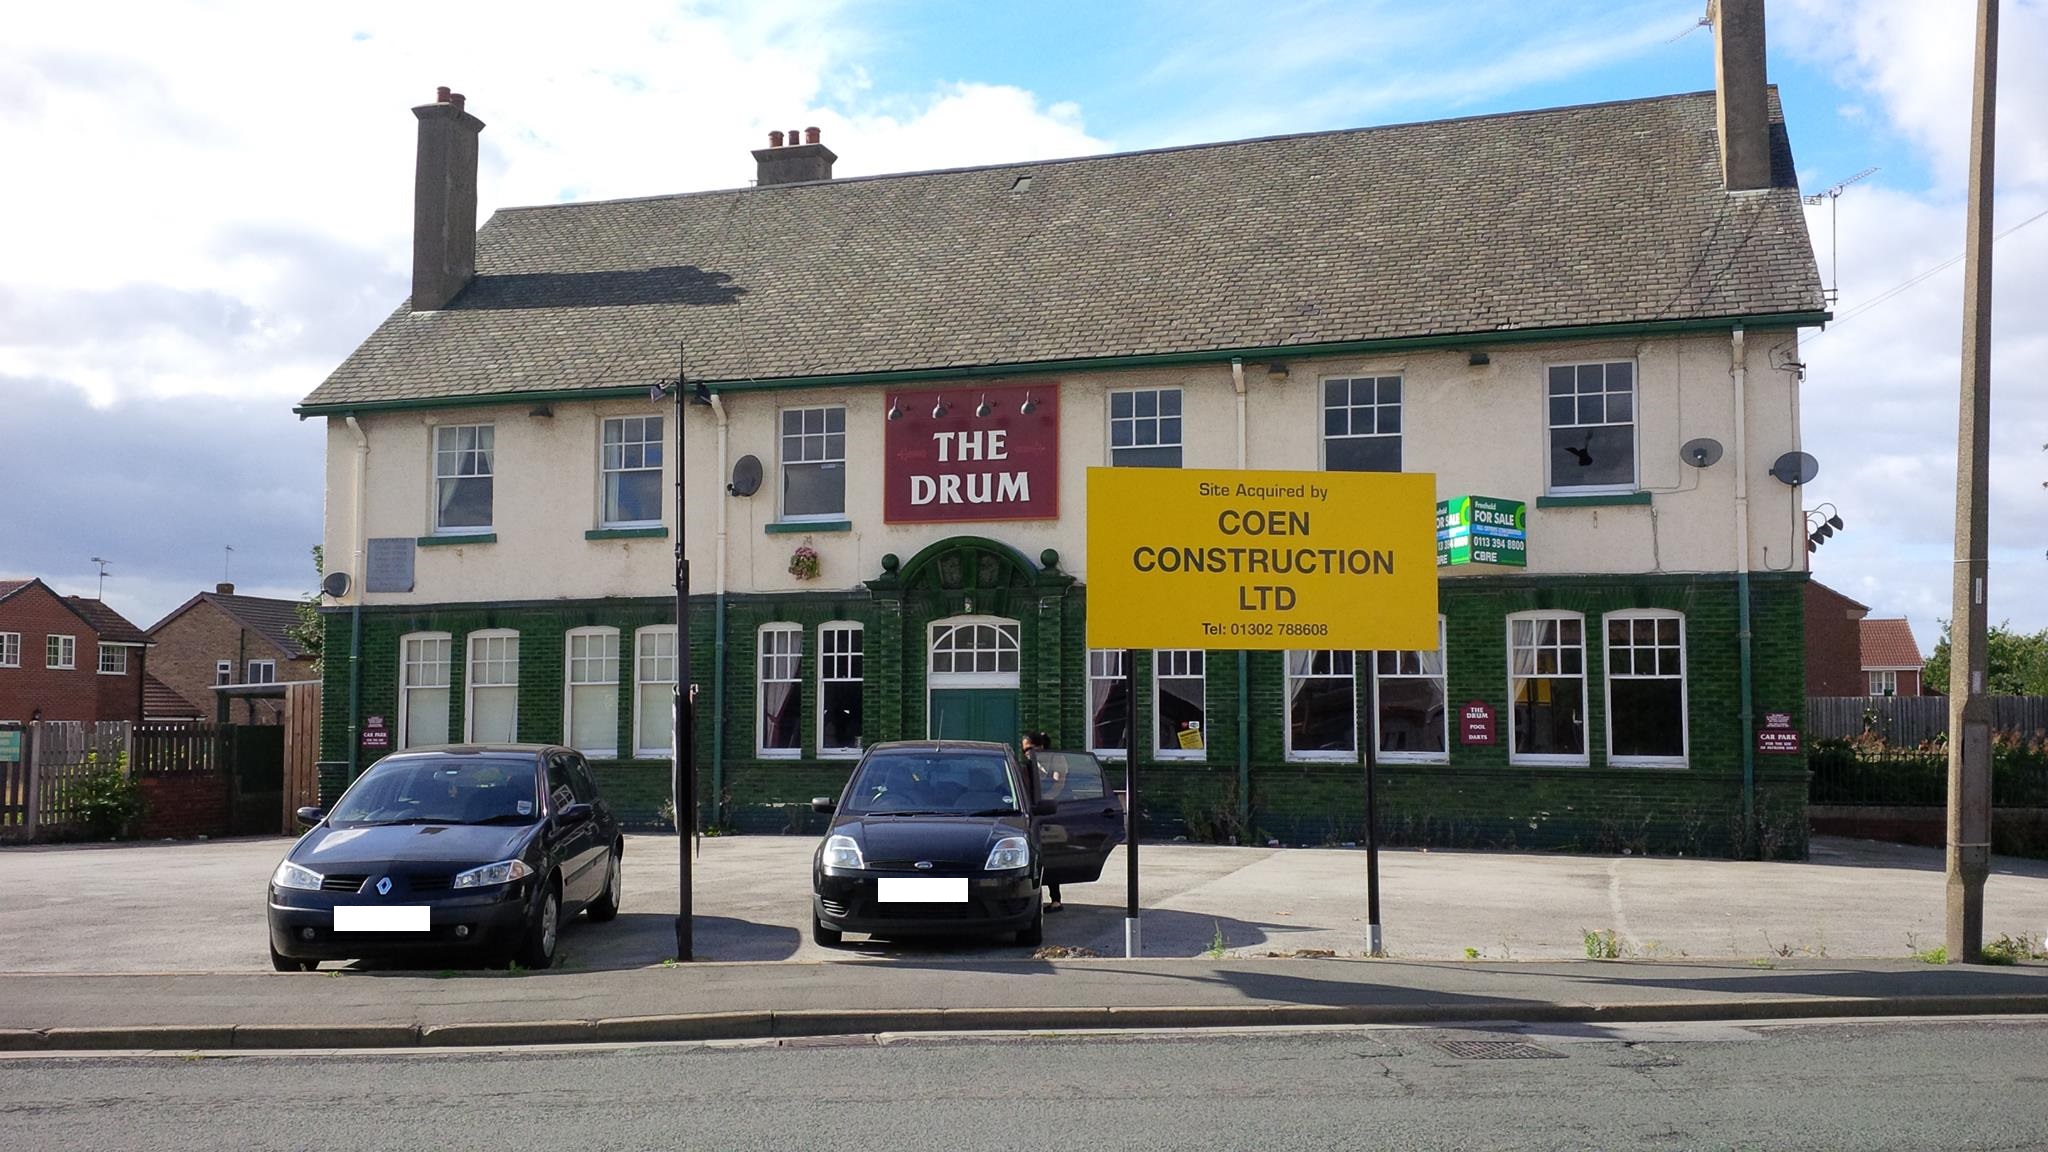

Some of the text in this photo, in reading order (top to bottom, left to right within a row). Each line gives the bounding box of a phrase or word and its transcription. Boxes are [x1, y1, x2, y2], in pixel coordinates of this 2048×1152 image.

[932, 429, 1009, 462] THE
[910, 471, 1030, 505] DRUM
[1199, 482, 1328, 501] Site Acquired by
[1218, 510, 1310, 536] COEN
[1474, 510, 1514, 526] FOR SALE
[1473, 536, 1525, 551] 0113 394 8800
[1133, 546, 1394, 575] CONSTRUCTION
[1473, 551, 1498, 562] CBRE
[1239, 586, 1297, 611] LTD
[1202, 623, 1328, 636] Tel: 01302 788608
